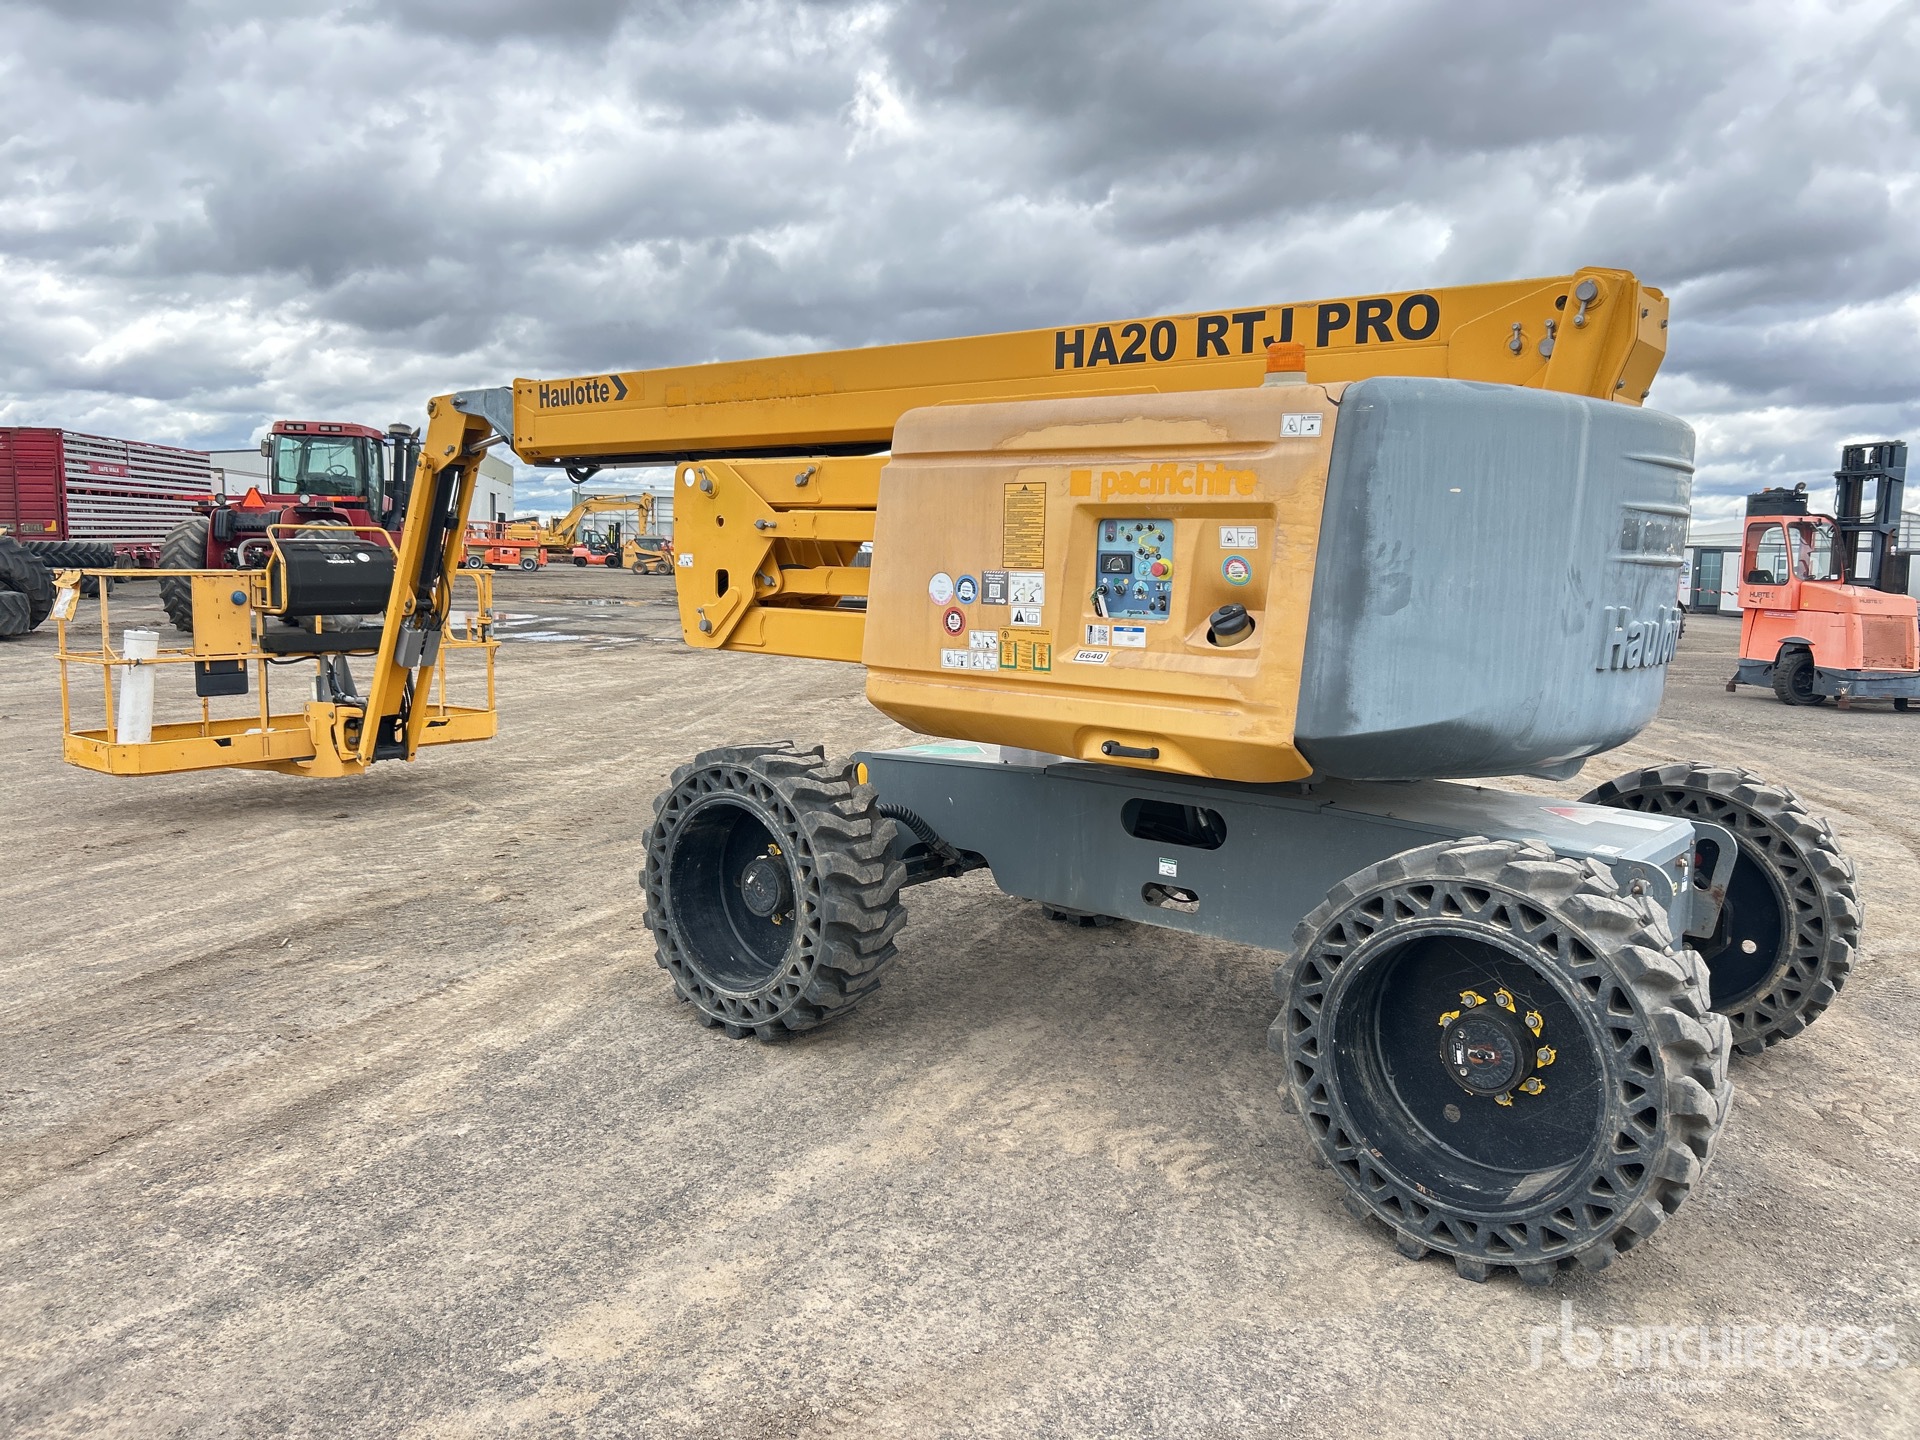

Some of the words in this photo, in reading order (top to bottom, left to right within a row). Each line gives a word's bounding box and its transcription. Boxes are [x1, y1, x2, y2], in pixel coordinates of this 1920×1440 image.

[1054, 319, 1177, 370] HA20
[1196, 307, 1295, 358] RTJ
[1316, 293, 1441, 348] PRO
[538, 379, 610, 409] Haulotte
[1079, 652, 1104, 660] 6640
